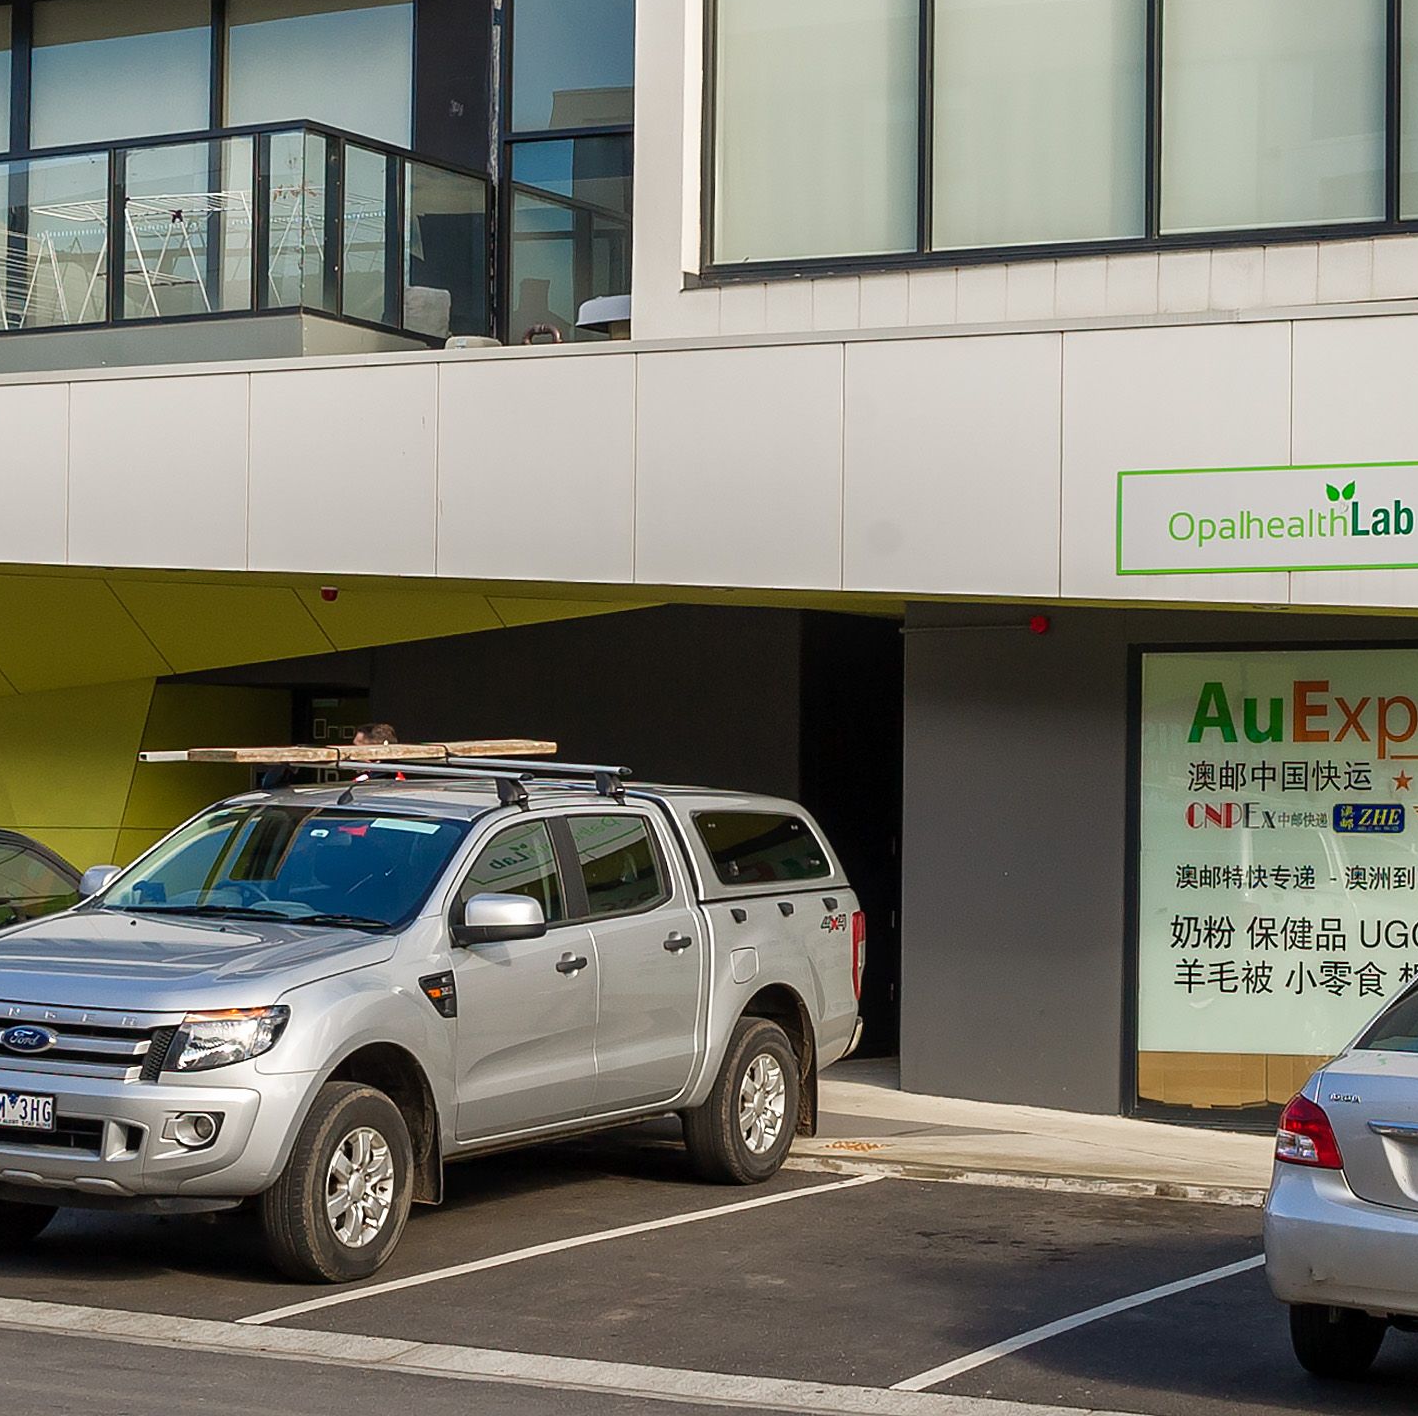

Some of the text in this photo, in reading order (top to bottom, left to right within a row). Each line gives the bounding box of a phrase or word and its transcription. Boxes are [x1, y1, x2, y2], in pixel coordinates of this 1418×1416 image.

[1187, 760, 1373, 792] 澳邮中国快运
[1175, 864, 1316, 890] 澳邮特快专递
[1170, 915, 1236, 950] 奶粉
[1246, 915, 1347, 951] 保健品
[1174, 959, 1274, 995] 羊毛被
[1285, 960, 1388, 997] 小零食
[9, 1028, 40, 1047] Ford
